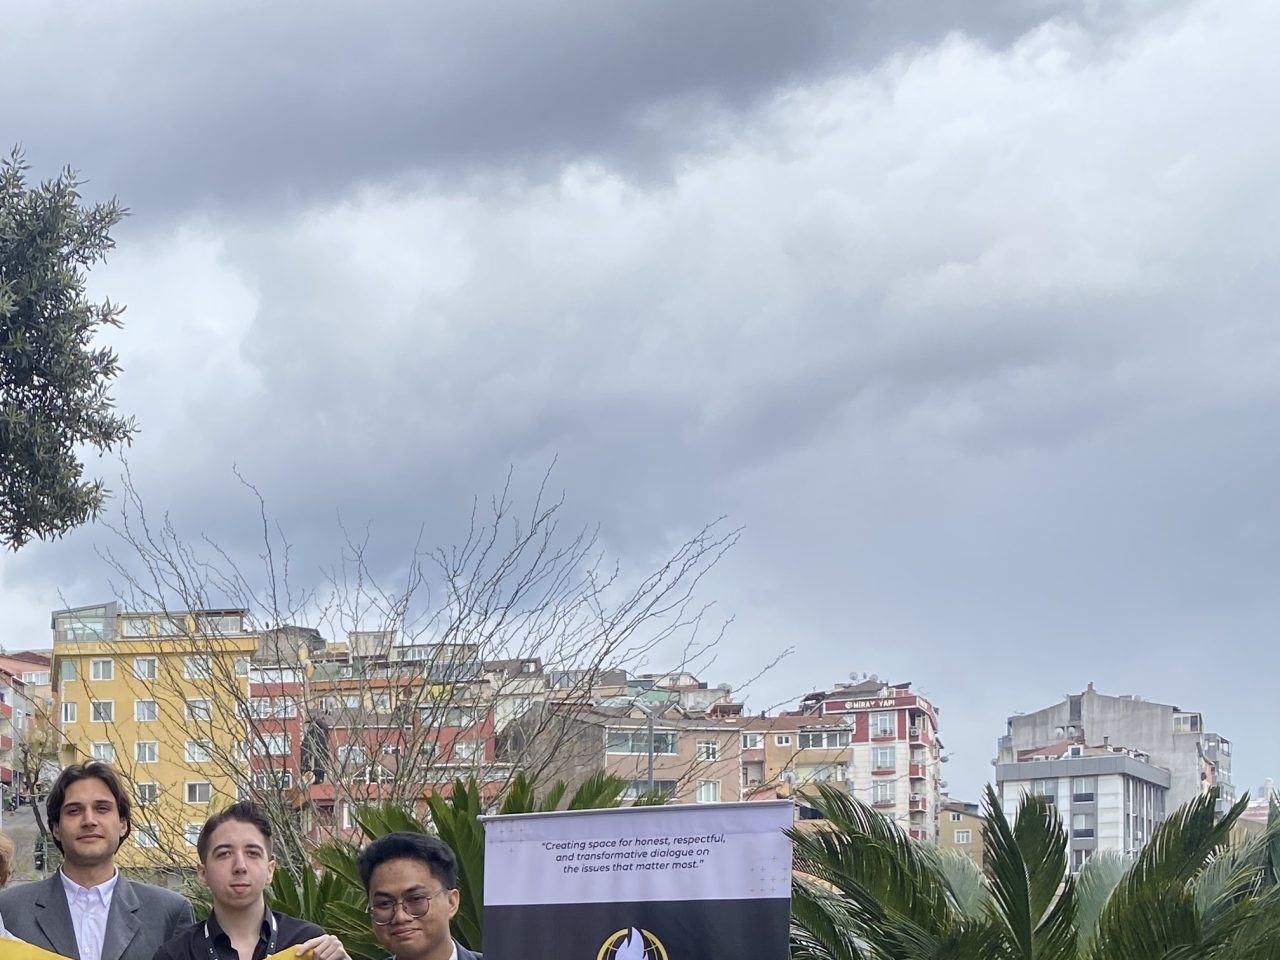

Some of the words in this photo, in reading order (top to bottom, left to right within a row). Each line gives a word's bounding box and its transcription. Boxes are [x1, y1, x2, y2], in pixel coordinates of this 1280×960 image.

[879, 699, 895, 707] YAPI
[588, 841, 616, 849] space
[619, 838, 633, 847] for
[634, 837, 671, 847] honest,
[673, 834, 726, 846] respectful,
[555, 853, 575, 862] and
[577, 851, 648, 861] transformative
[650, 848, 694, 859] dialogue
[563, 864, 580, 873] the
[581, 864, 610, 873] issues
[612, 862, 634, 872] that
[635, 861, 670, 871] matter
